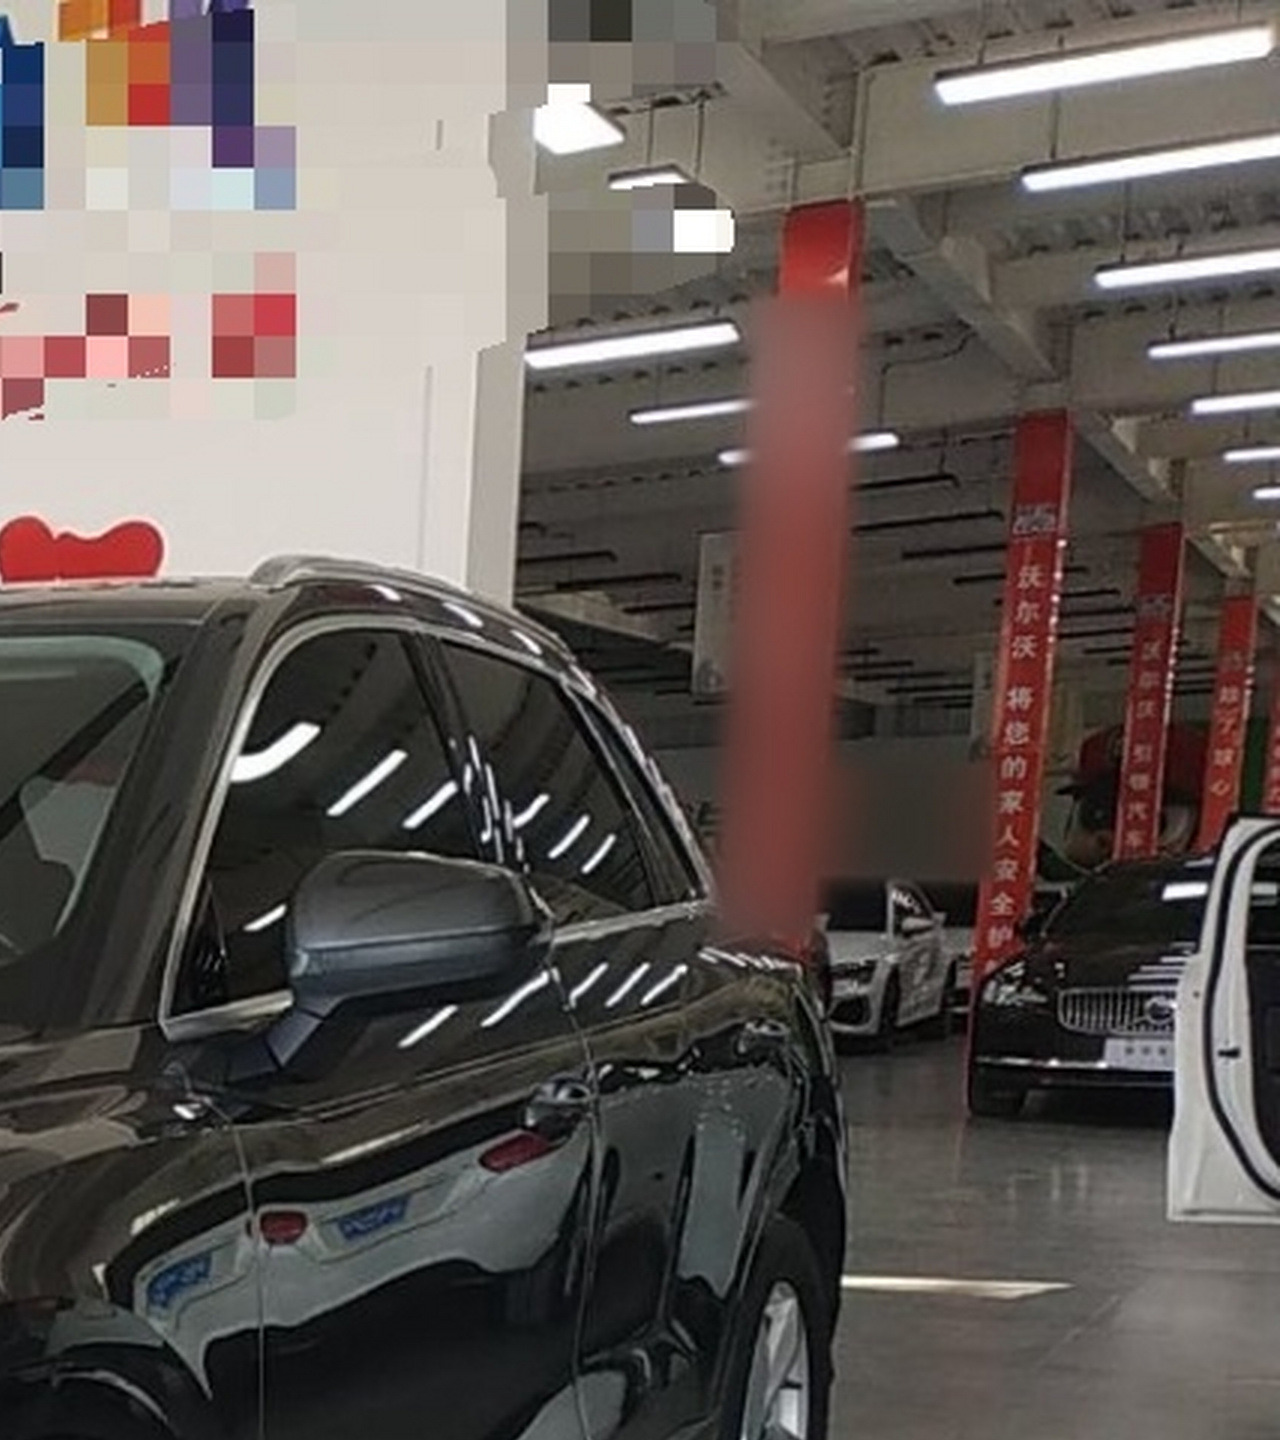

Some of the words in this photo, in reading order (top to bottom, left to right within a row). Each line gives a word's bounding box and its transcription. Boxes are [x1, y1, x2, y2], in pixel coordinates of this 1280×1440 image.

[1011, 565, 1044, 660] 沃尔沃
[986, 686, 1034, 974] 将您的家人安全护
